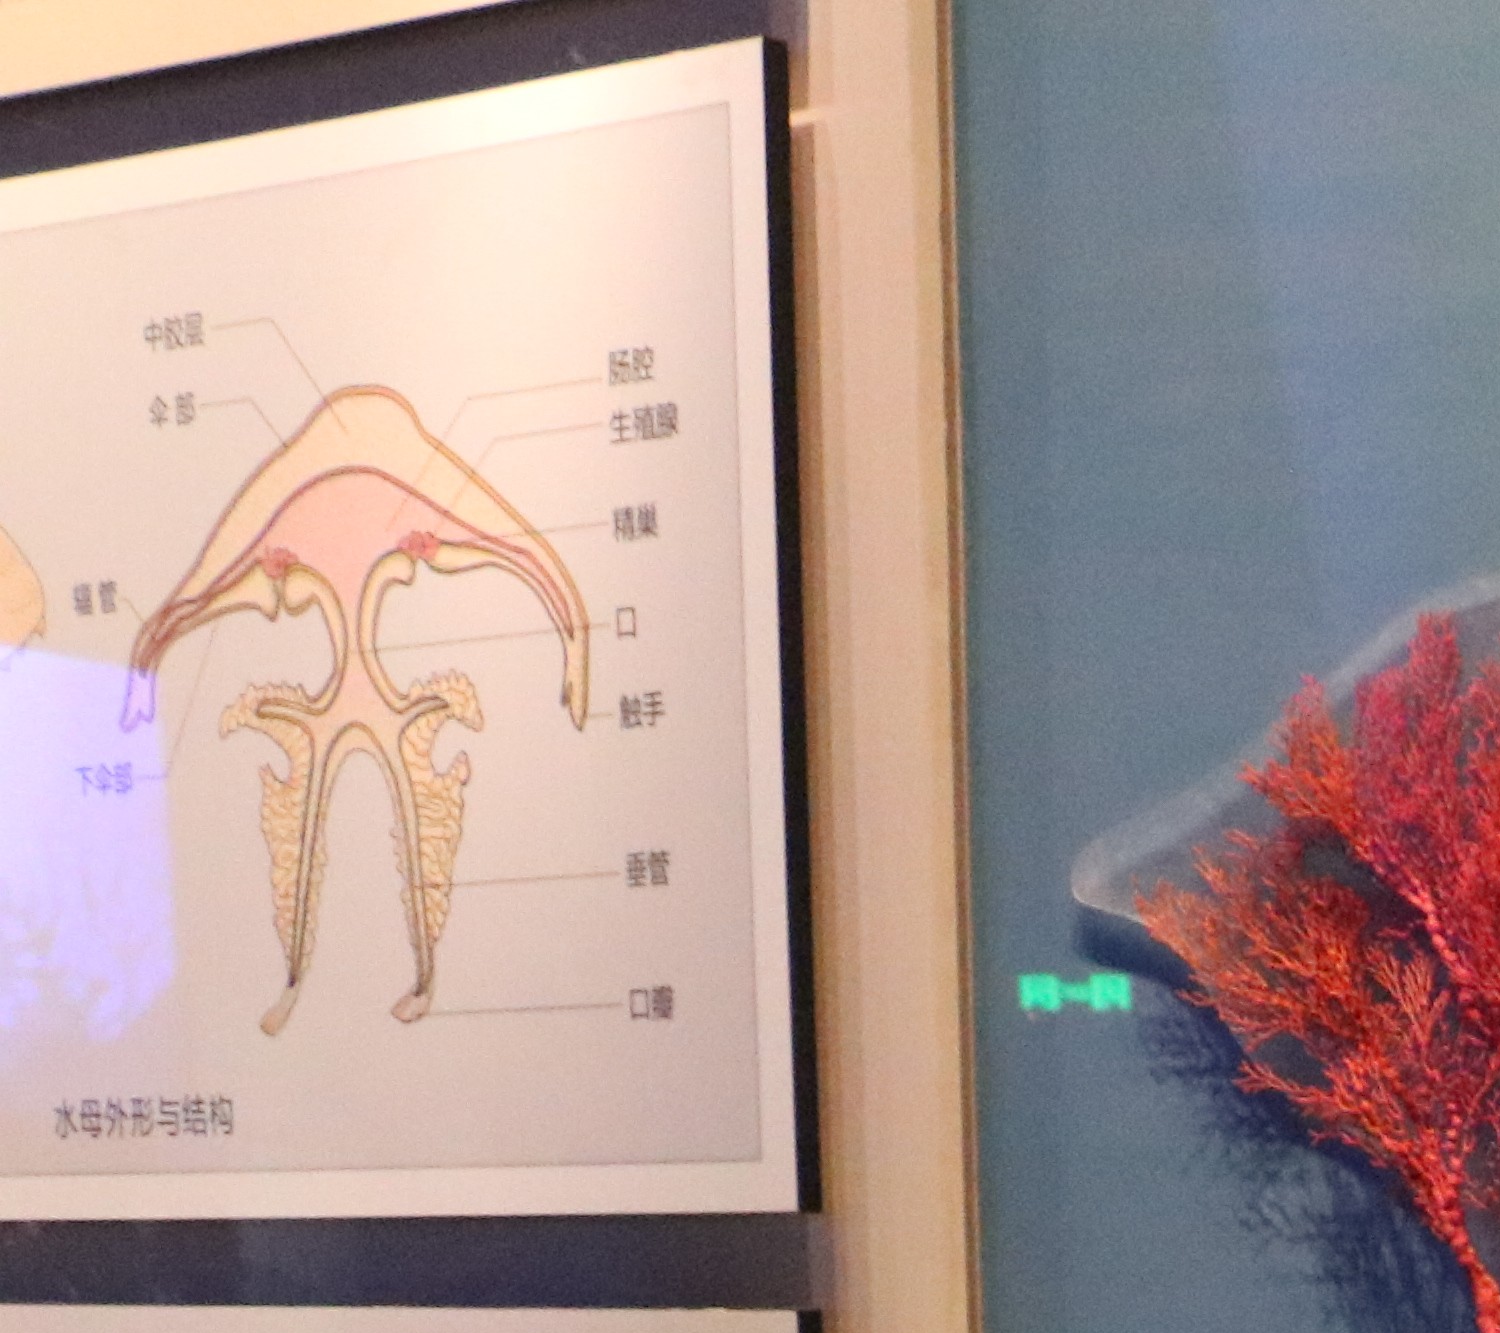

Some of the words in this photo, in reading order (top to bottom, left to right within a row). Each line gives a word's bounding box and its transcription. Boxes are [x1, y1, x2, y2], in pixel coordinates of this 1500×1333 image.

[143, 311, 205, 351] 中胶层
[609, 402, 679, 445] 生殖腺
[616, 607, 637, 638] 口
[619, 690, 666, 729] 触手
[626, 850, 669, 887] 垂管
[54, 1096, 234, 1138] 水母外形与结构
